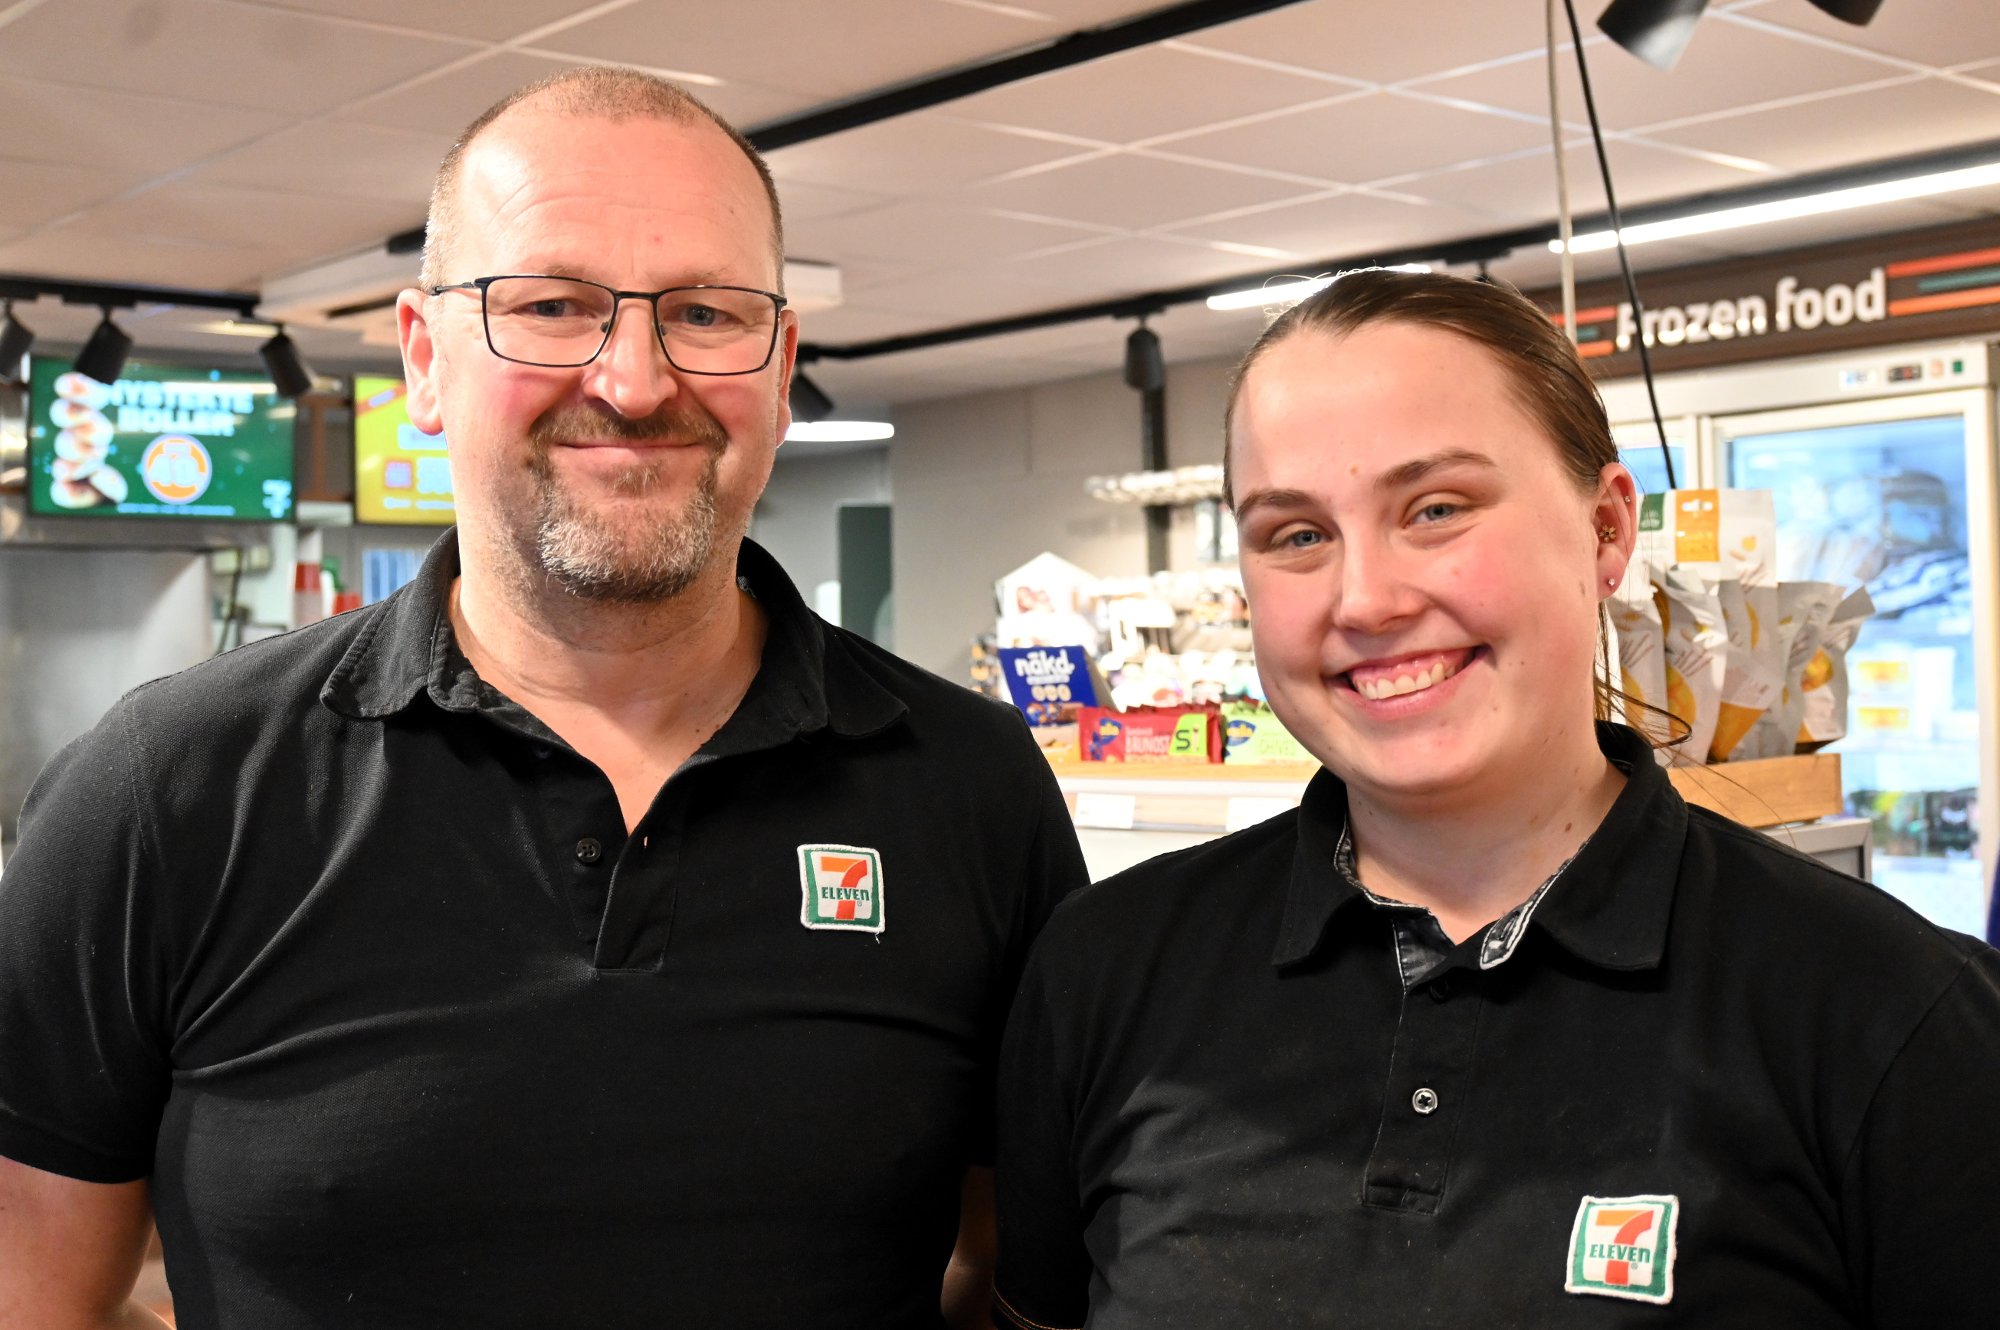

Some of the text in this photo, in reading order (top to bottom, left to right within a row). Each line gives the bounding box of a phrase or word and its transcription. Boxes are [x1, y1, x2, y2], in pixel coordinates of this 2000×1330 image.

[1616, 268, 1886, 351] Frozen food
[821, 856, 868, 920] 7
[1595, 1210, 1655, 1286] 7
